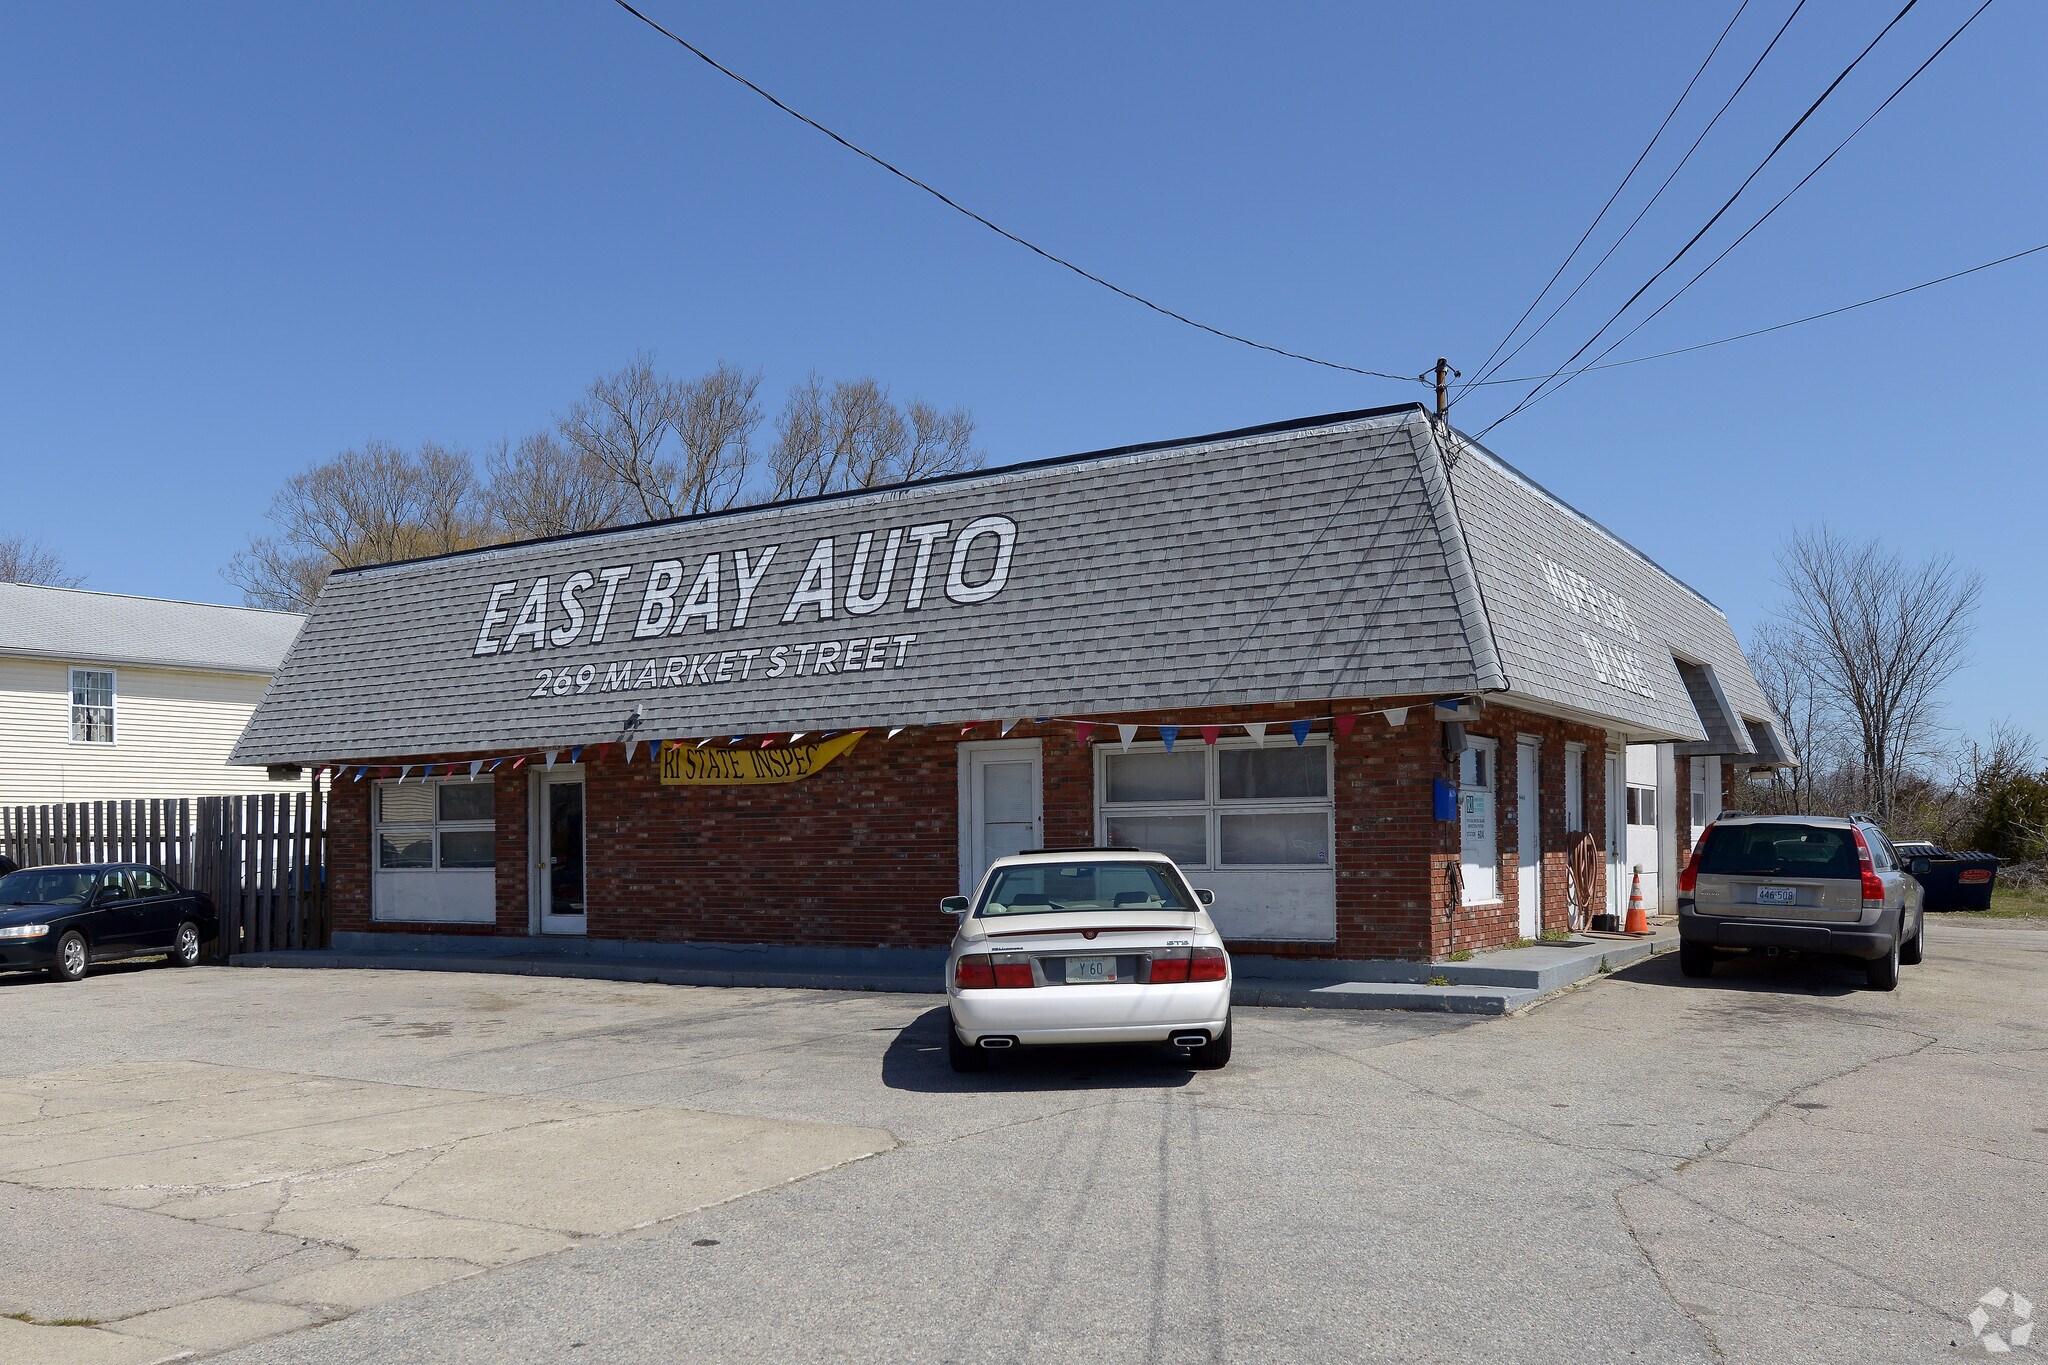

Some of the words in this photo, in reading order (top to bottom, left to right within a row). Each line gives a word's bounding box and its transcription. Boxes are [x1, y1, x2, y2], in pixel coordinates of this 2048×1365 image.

[472, 564, 632, 657] EAST
[632, 544, 781, 639] BAY
[781, 513, 1019, 625] AUTO
[530, 662, 596, 698] 269
[600, 647, 762, 694] MARKET
[765, 634, 918, 680] STREET
[663, 748, 680, 779] RI
[685, 749, 745, 779] STATE
[1759, 890, 1775, 900] 446
[1777, 890, 1793, 901] 508
[1079, 962, 1086, 975] Y
[1089, 962, 1103, 975] 60
